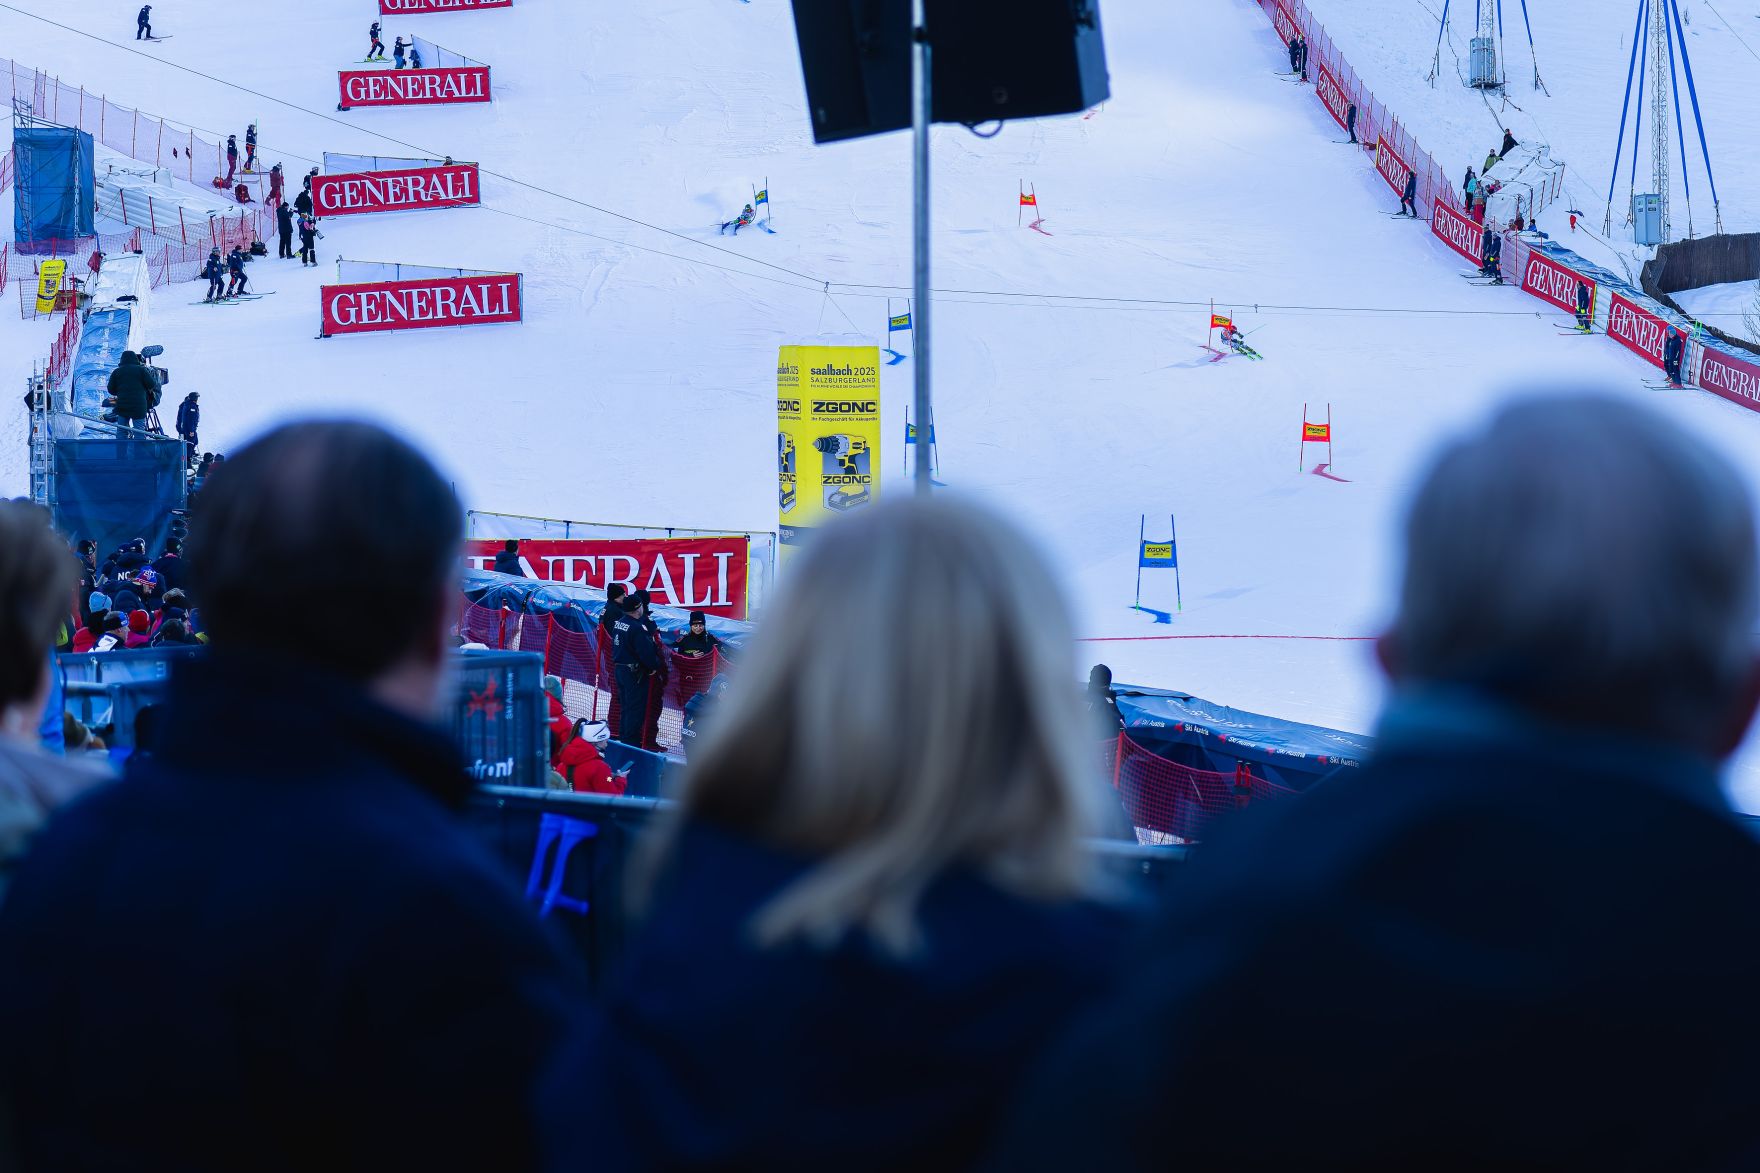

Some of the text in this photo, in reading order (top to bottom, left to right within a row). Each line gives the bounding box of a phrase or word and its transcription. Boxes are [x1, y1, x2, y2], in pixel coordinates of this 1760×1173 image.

[346, 73, 485, 101] GENERALI
[319, 171, 473, 209] GENERALI
[1434, 204, 1483, 260] GENERALI
[1527, 260, 1592, 316] GENERAI
[331, 283, 513, 326] GENERALI
[1611, 302, 1666, 362] GENERA
[810, 363, 876, 376] saalbach 2025
[813, 401, 876, 413] ZGONC
[822, 475, 871, 485] ZGONC
[1184, 723, 1209, 736] Ski Austria
[1329, 755, 1360, 768] Ski Austria
